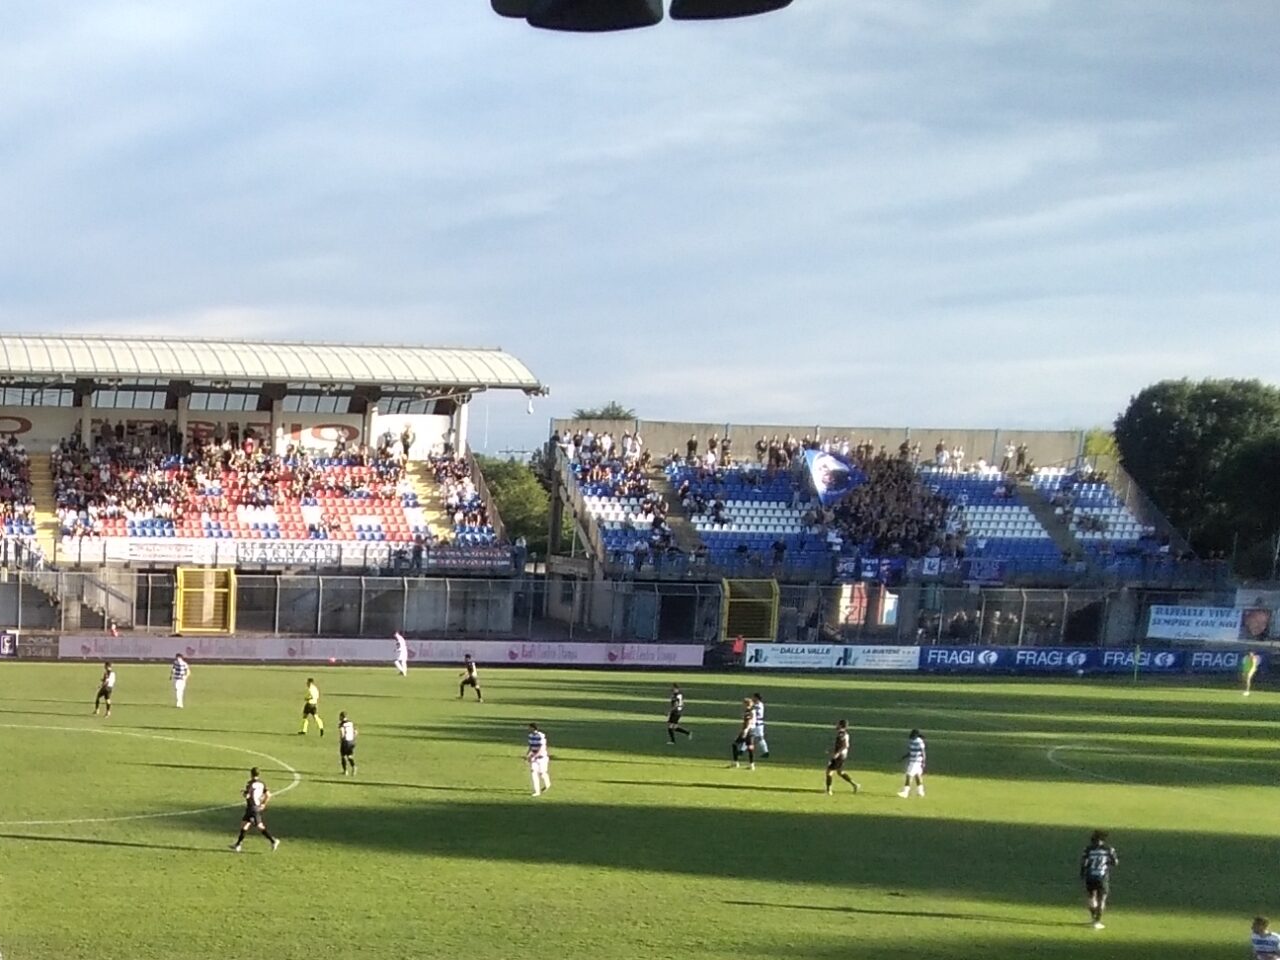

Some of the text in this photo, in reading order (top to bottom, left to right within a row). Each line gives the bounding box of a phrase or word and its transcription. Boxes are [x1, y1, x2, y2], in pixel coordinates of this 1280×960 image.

[780, 647, 806, 655] DALLA
[807, 647, 831, 655] VALLE
[927, 650, 974, 664] FRAGI
[1016, 650, 1063, 665] FRAGI
[1103, 651, 1150, 666] FRAGI
[1191, 652, 1239, 667] FRAGI
